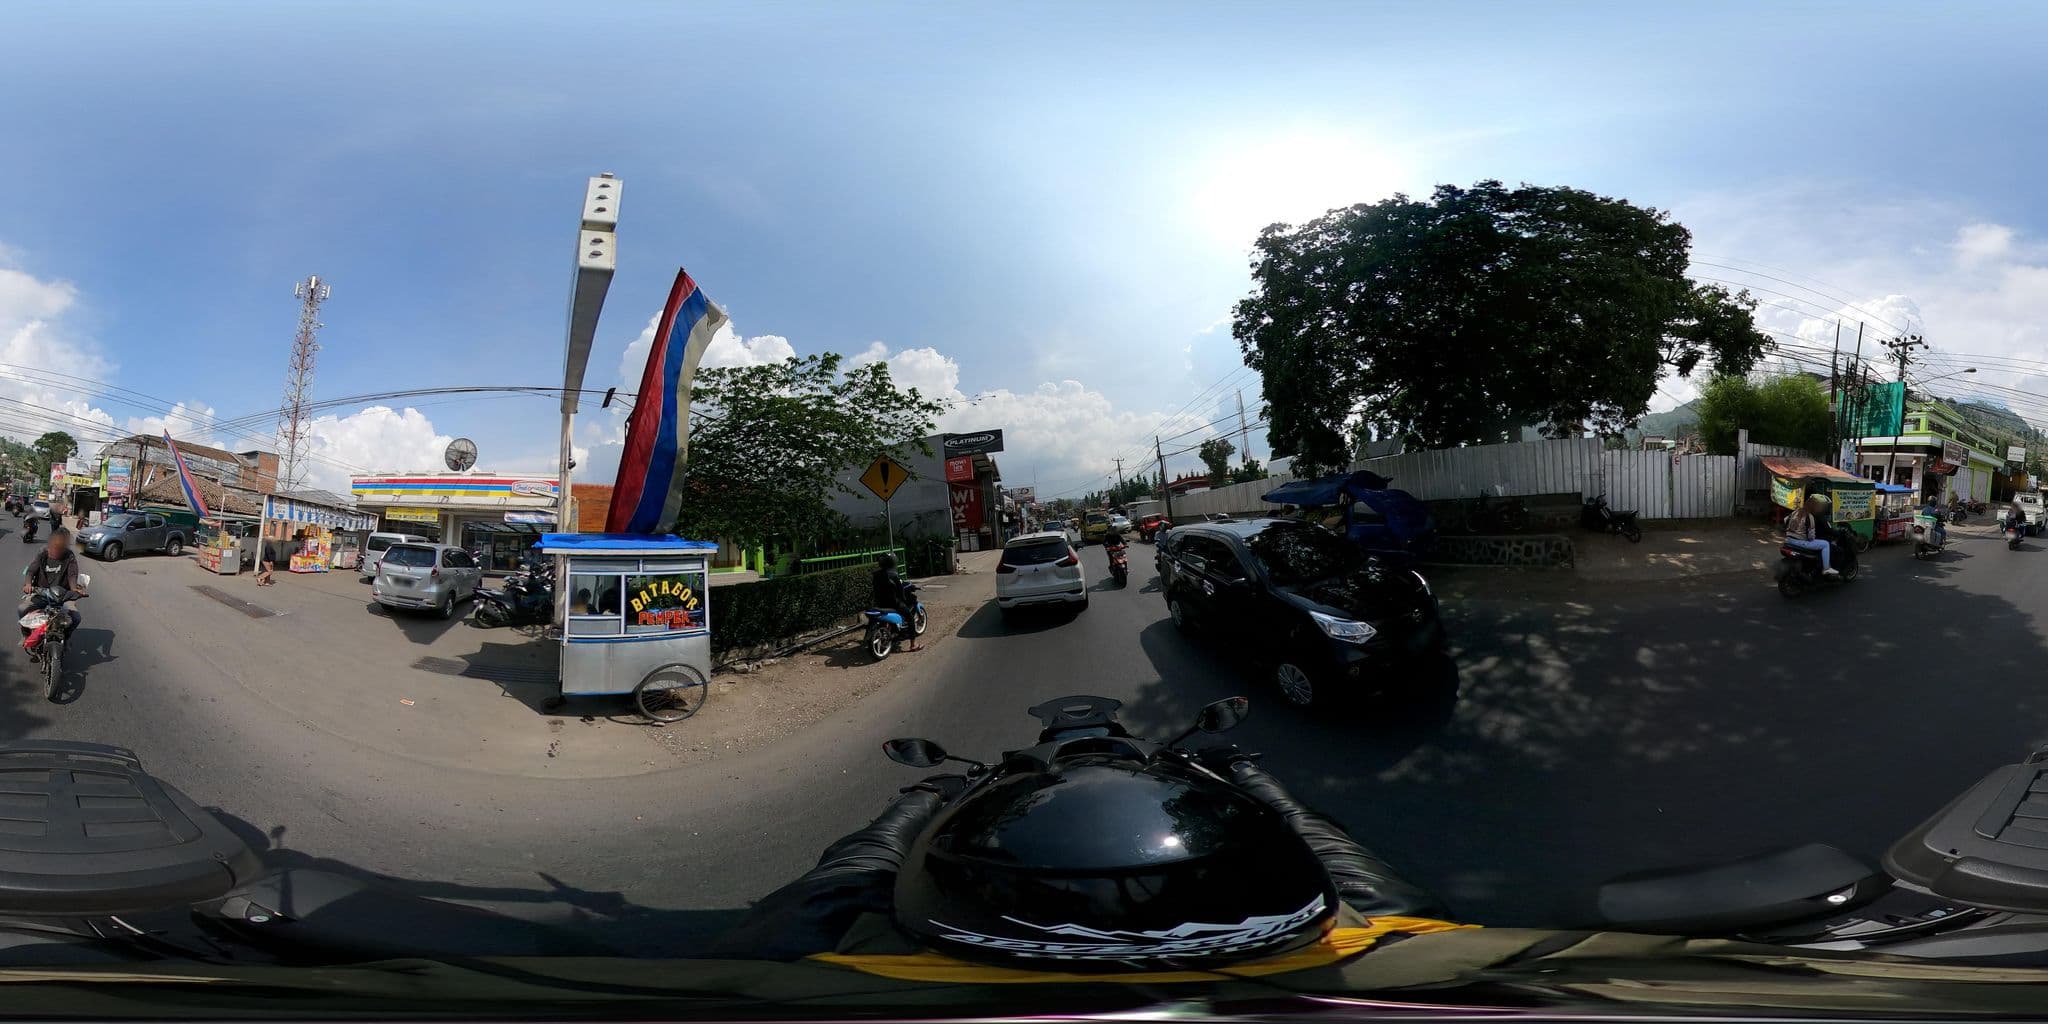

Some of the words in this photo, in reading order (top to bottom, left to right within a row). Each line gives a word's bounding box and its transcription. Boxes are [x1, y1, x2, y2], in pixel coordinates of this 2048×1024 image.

[949, 436, 989, 445] PLATINUM
[630, 581, 698, 613] BATAGOR
[638, 609, 690, 625] PEMPEK
[1009, 934, 1300, 960] HONDA
